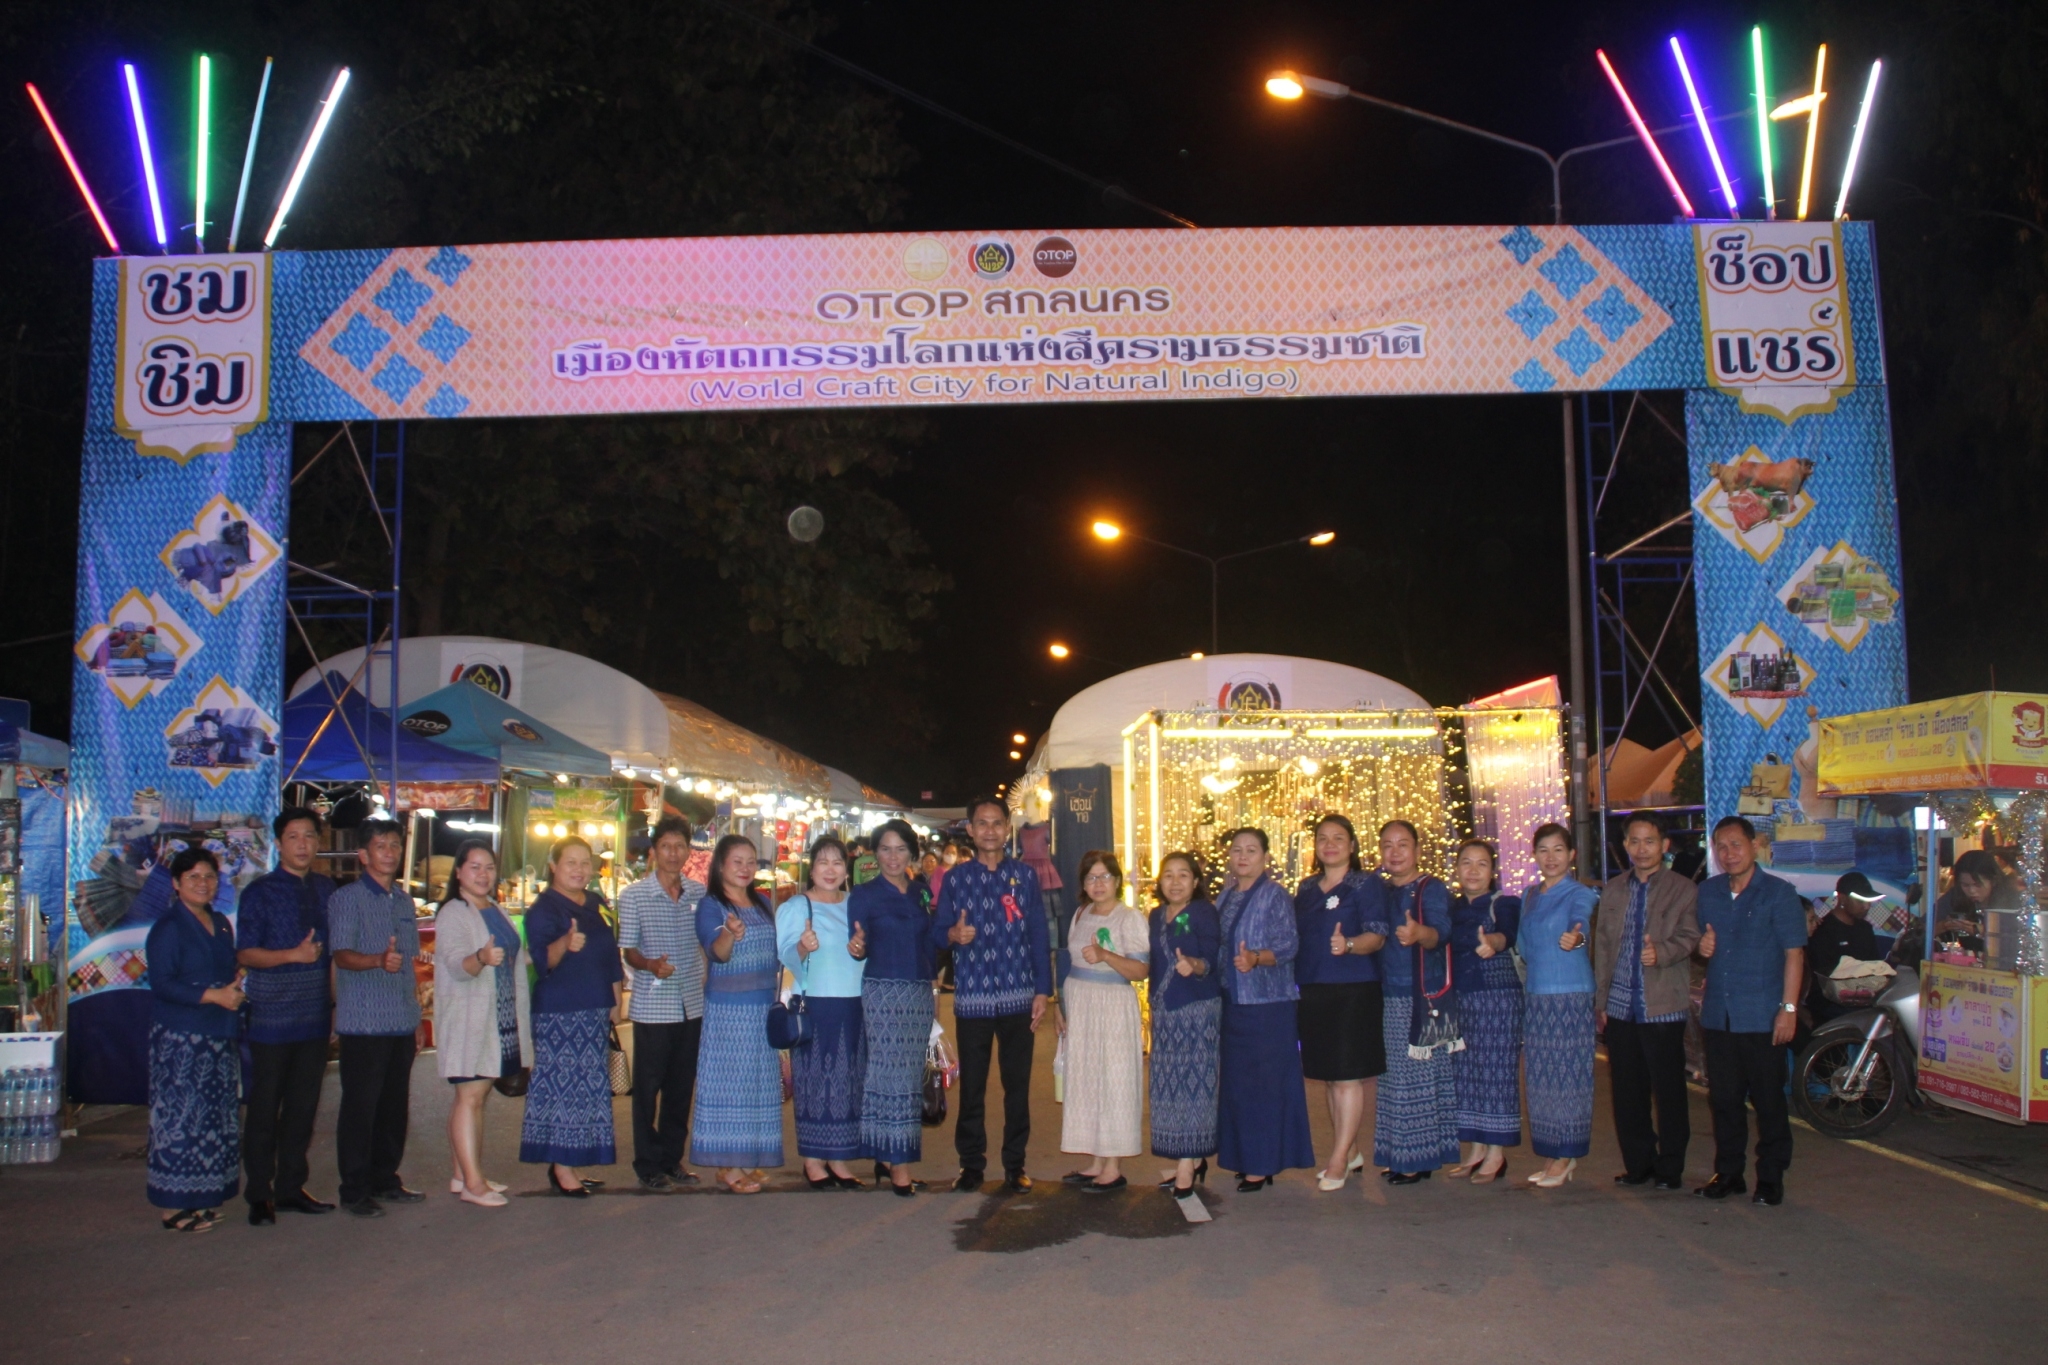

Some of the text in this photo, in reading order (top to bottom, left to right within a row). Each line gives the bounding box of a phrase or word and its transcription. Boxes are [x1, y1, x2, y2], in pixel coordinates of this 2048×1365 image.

[1036, 250, 1074, 260] OTOP
[1709, 234, 1831, 286] ช็อป
[147, 270, 247, 315] ชม
[816, 287, 1170, 320] OTOP สกลนคร
[556, 325, 1423, 376] เมืองหัตถกรรมโลกแห่งสีครามธรรมชาติ
[1718, 306, 1836, 374] แชร์
[144, 343, 244, 407] ชิม
[689, 367, 1298, 402] (World Craft City for Natural Indigo)
[402, 718, 448, 731] OTOP
[1984, 1041, 1995, 1053] 20
